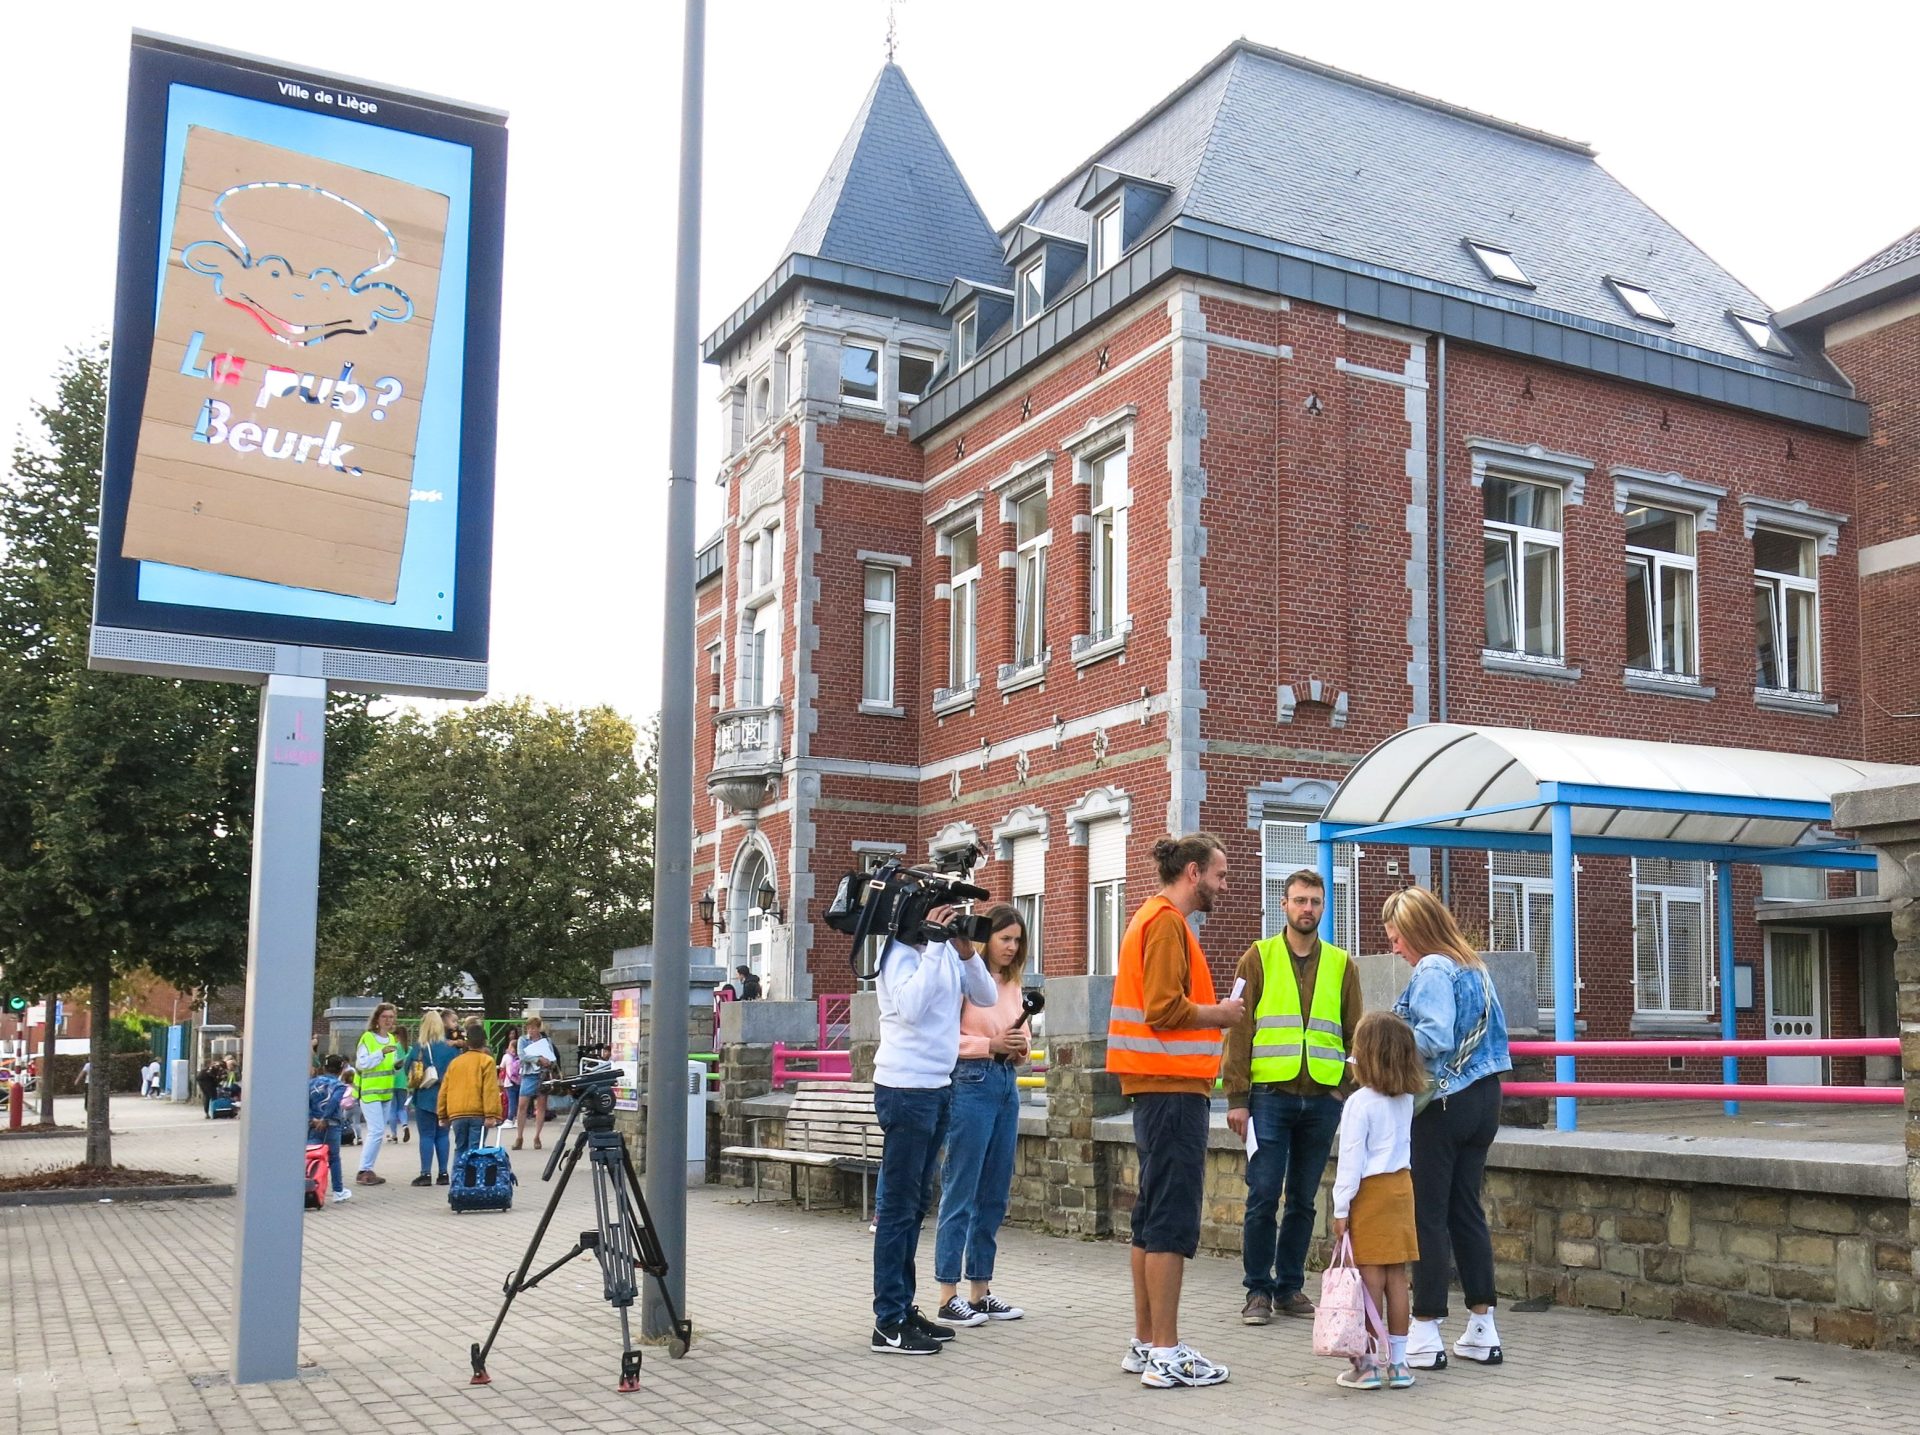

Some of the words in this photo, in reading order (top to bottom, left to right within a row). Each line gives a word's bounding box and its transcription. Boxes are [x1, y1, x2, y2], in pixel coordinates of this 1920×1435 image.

[277, 81, 309, 99] Ville
[314, 91, 333, 104] de
[337, 94, 378, 114] Liège
[255, 360, 403, 421] pub?
[191, 398, 363, 477] Beurk.
